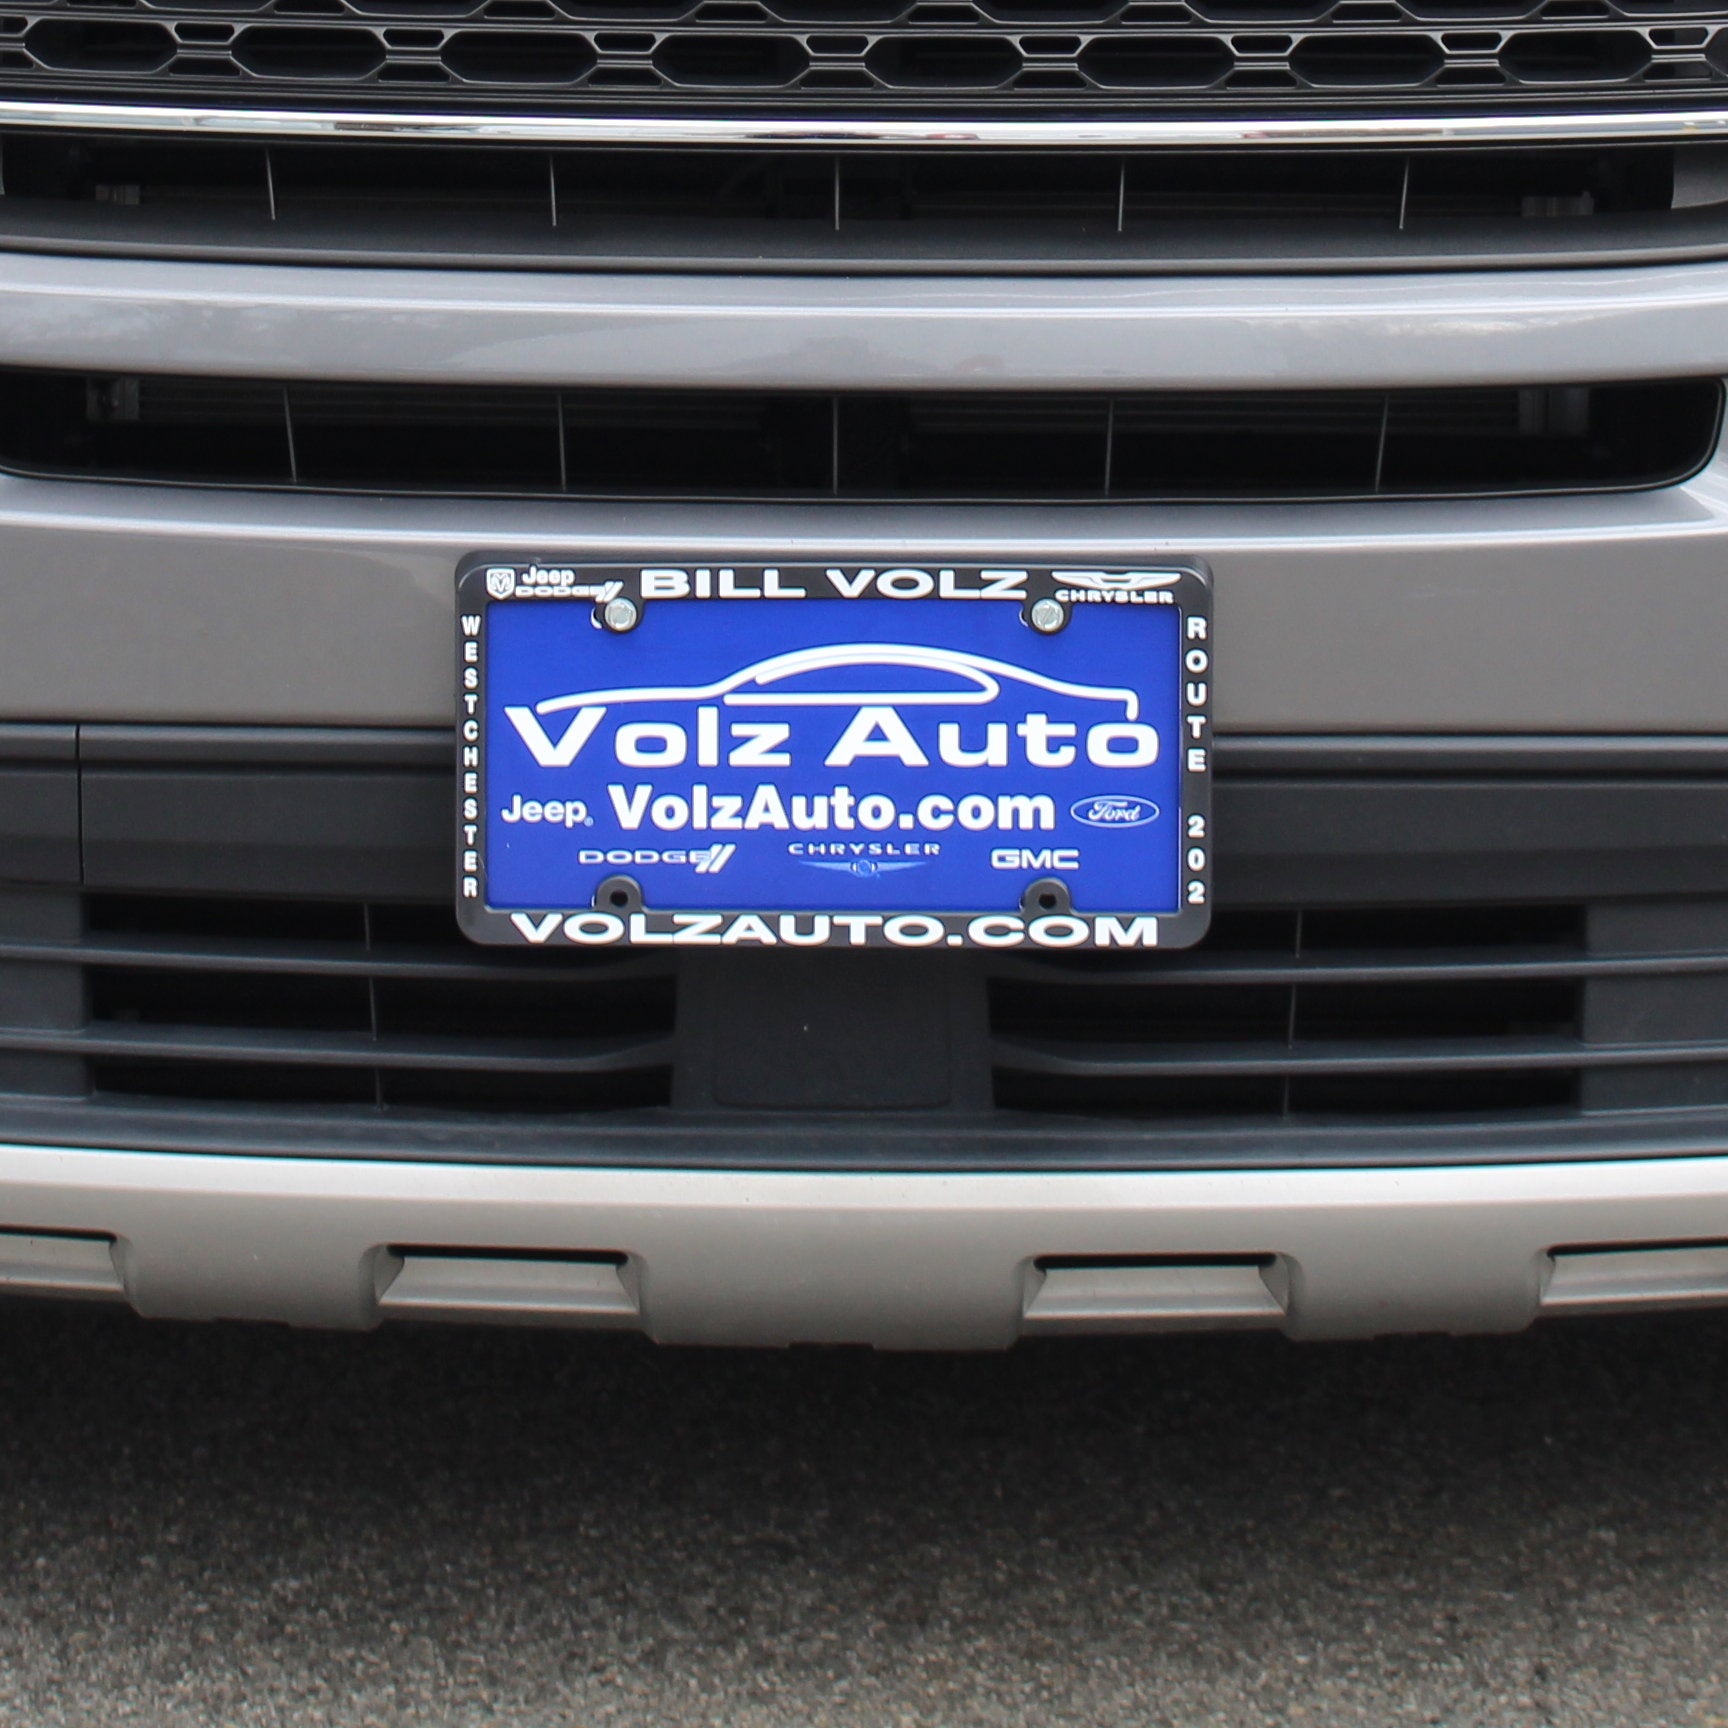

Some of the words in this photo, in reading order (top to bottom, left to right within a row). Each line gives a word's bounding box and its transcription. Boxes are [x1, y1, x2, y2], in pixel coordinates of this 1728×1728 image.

[521, 566, 574, 587] Jeep
[640, 569, 806, 599] BILL
[826, 569, 1028, 599] VOLZ
[1055, 589, 1174, 604] CHRYSLER
[1185, 616, 1209, 772] ROUTE
[504, 706, 792, 768] Volz
[825, 706, 1160, 768] Auto
[461, 615, 482, 898] WESTCHESTER
[501, 795, 588, 828] Jeep
[607, 784, 1055, 830] VolzAuto.com
[1087, 801, 1141, 822] Ford
[578, 849, 710, 865] DODGE
[788, 843, 941, 855] CHRYSLER
[991, 849, 1080, 870] GMC
[1187, 815, 1206, 904] 202
[511, 913, 1159, 948] VOLZAUTO.COM
